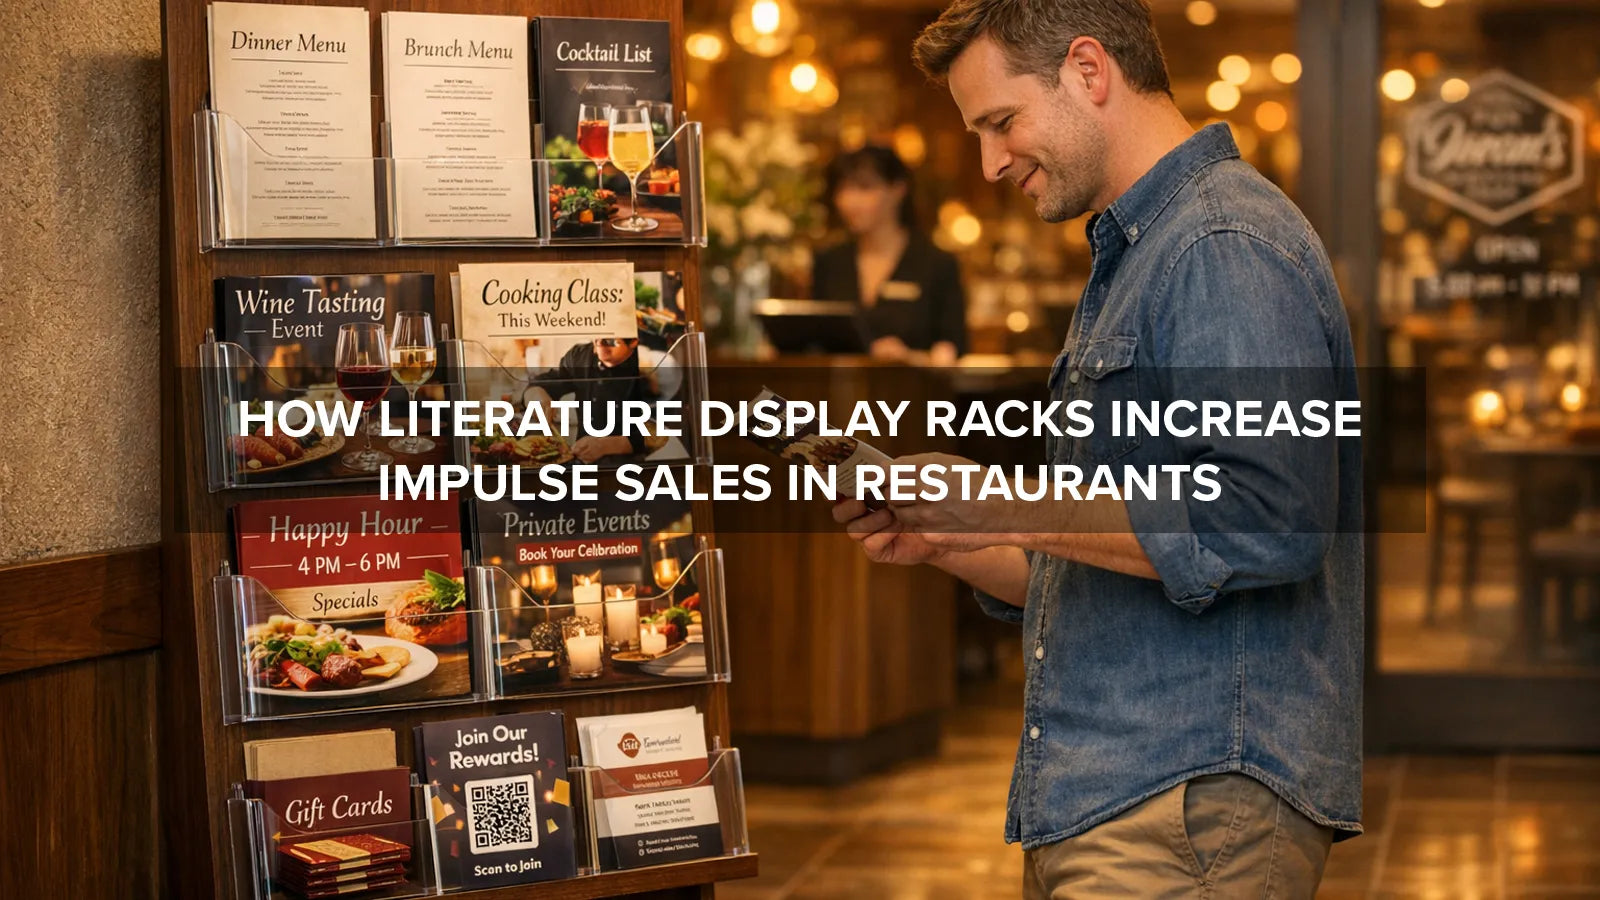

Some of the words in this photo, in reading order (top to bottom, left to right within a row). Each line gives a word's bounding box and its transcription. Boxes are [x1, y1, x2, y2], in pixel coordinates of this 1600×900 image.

[231, 30, 293, 52] Dinner
[297, 33, 347, 53] Menu
[404, 38, 463, 58] Brunch
[467, 40, 513, 60] Menu
[556, 41, 619, 62] Cocktail
[624, 43, 653, 63] List
[235, 290, 295, 315] Wine
[302, 289, 386, 321] Tasting
[482, 279, 563, 311] Cooking
[567, 278, 624, 304] Class:
[271, 318, 324, 339] Event
[497, 312, 531, 328] This
[534, 311, 606, 328] Weekend!
[269, 515, 350, 549] Happy
[360, 510, 423, 537] Hour
[503, 511, 576, 538] Private
[583, 508, 650, 534] Events
[298, 556, 310, 575] 4
[315, 556, 340, 575] PM
[359, 554, 371, 572] 6
[376, 552, 401, 570] PM
[519, 547, 547, 562] Book
[550, 545, 576, 560] Your
[312, 589, 379, 615] Specials
[455, 728, 489, 748] Join
[493, 724, 528, 742] Our
[449, 743, 540, 769] Rewards!
[285, 797, 325, 828] Gift
[332, 790, 393, 819] Cards
[505, 863, 518, 873] to
[519, 858, 542, 874] Join
